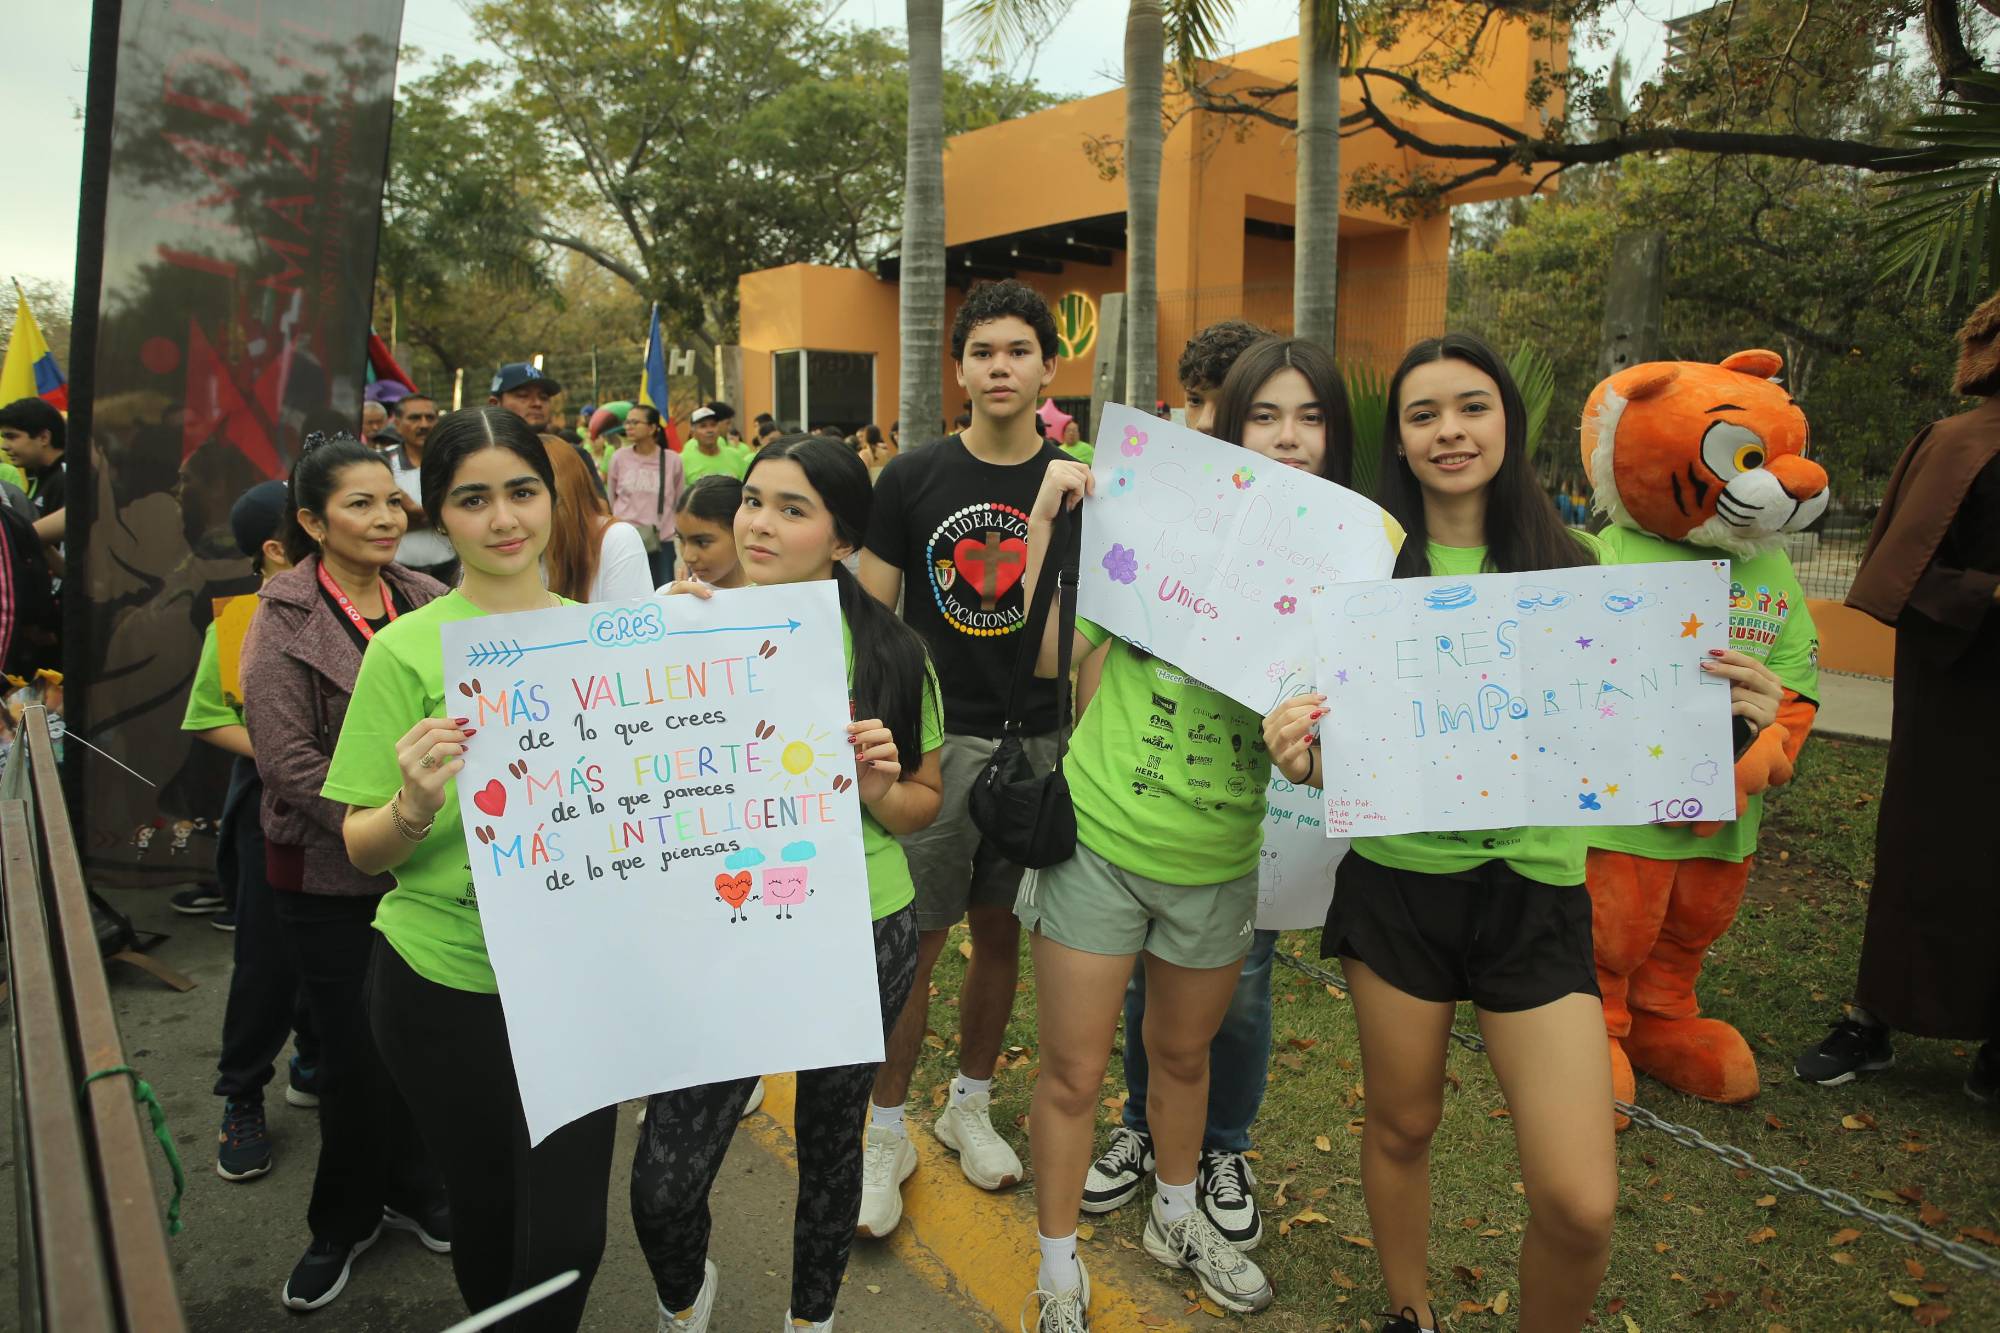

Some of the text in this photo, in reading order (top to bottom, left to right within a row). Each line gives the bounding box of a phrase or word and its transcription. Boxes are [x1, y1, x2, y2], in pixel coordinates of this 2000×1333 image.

[669, 348, 696, 377] H
[1139, 461, 1233, 534] Ser
[1152, 528, 1201, 576] Nos
[944, 594, 1024, 628] VOCACIONAL
[1157, 575, 1219, 620] Unicos
[1395, 619, 1519, 681] ERES
[1728, 626, 1777, 646] LUSIVA
[518, 709, 727, 752] de lo que crees
[1135, 766, 1164, 781] HERSA
[551, 783, 736, 824] de lo que pareces
[1266, 801, 1320, 829] lugar para
[1647, 798, 1703, 824] ICO
[546, 838, 741, 891] de lo que piensas
